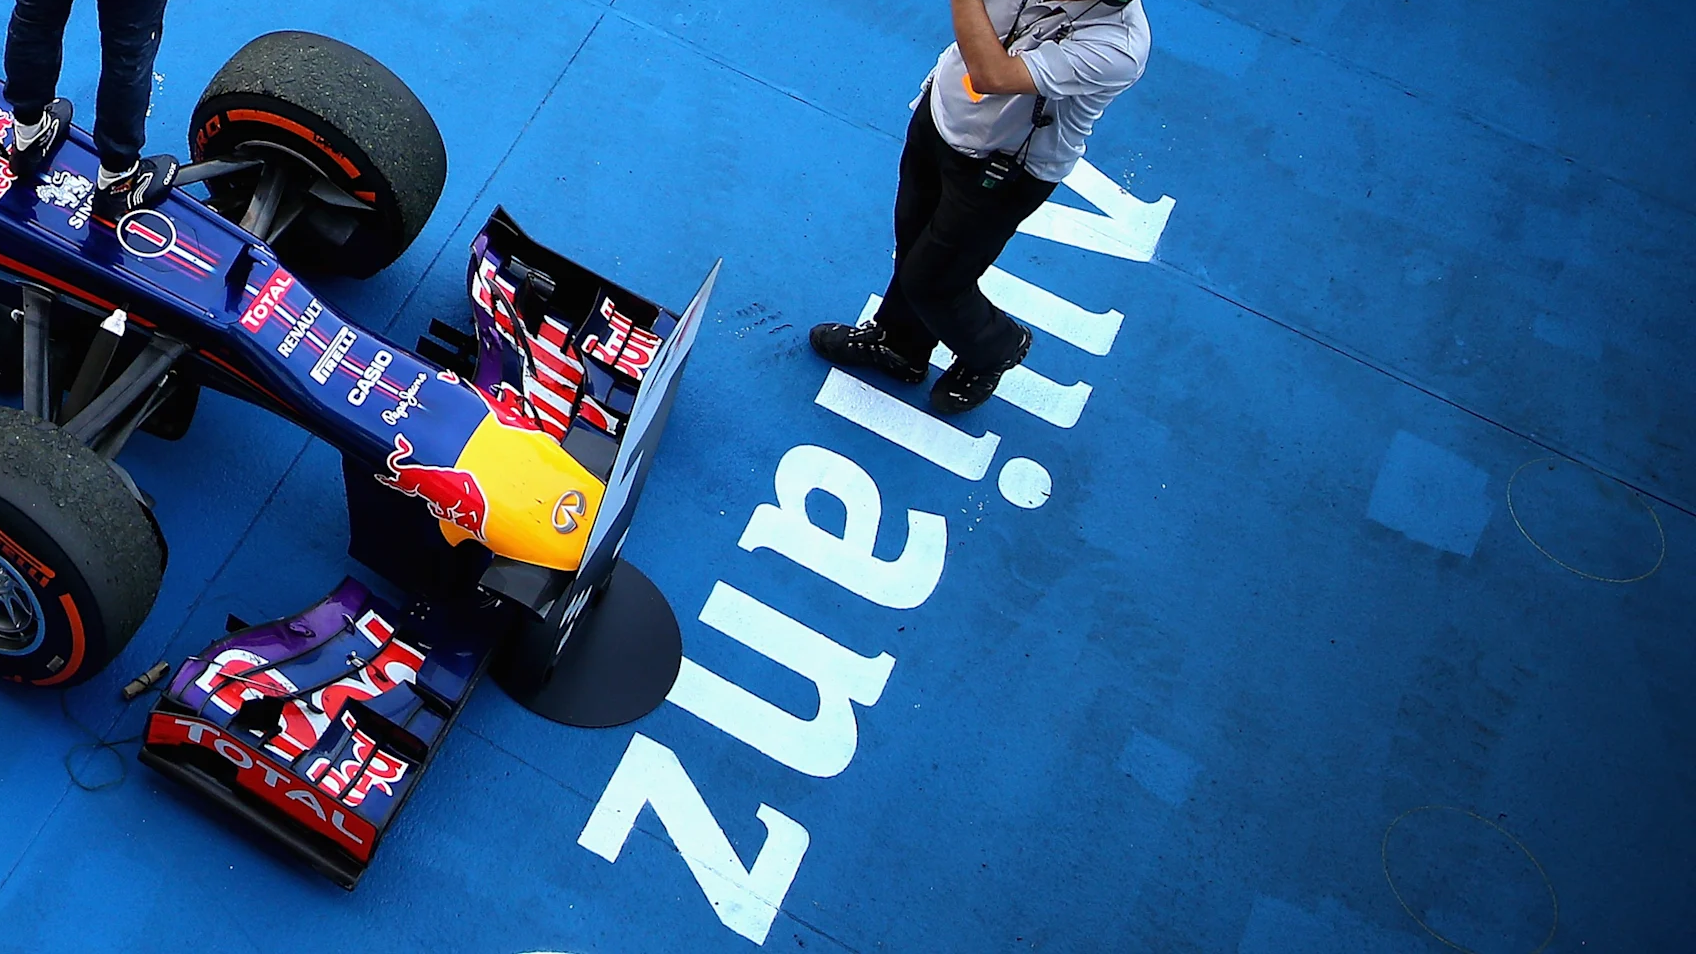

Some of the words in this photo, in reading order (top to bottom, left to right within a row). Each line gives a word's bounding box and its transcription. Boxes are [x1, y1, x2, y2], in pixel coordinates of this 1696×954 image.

[125, 220, 167, 247] 1
[241, 275, 292, 328] TOTAL
[276, 297, 324, 359] RENAULT
[309, 325, 358, 385] PIRELLI
[347, 349, 393, 407] CASIO
[175, 718, 364, 845] TOTAL
